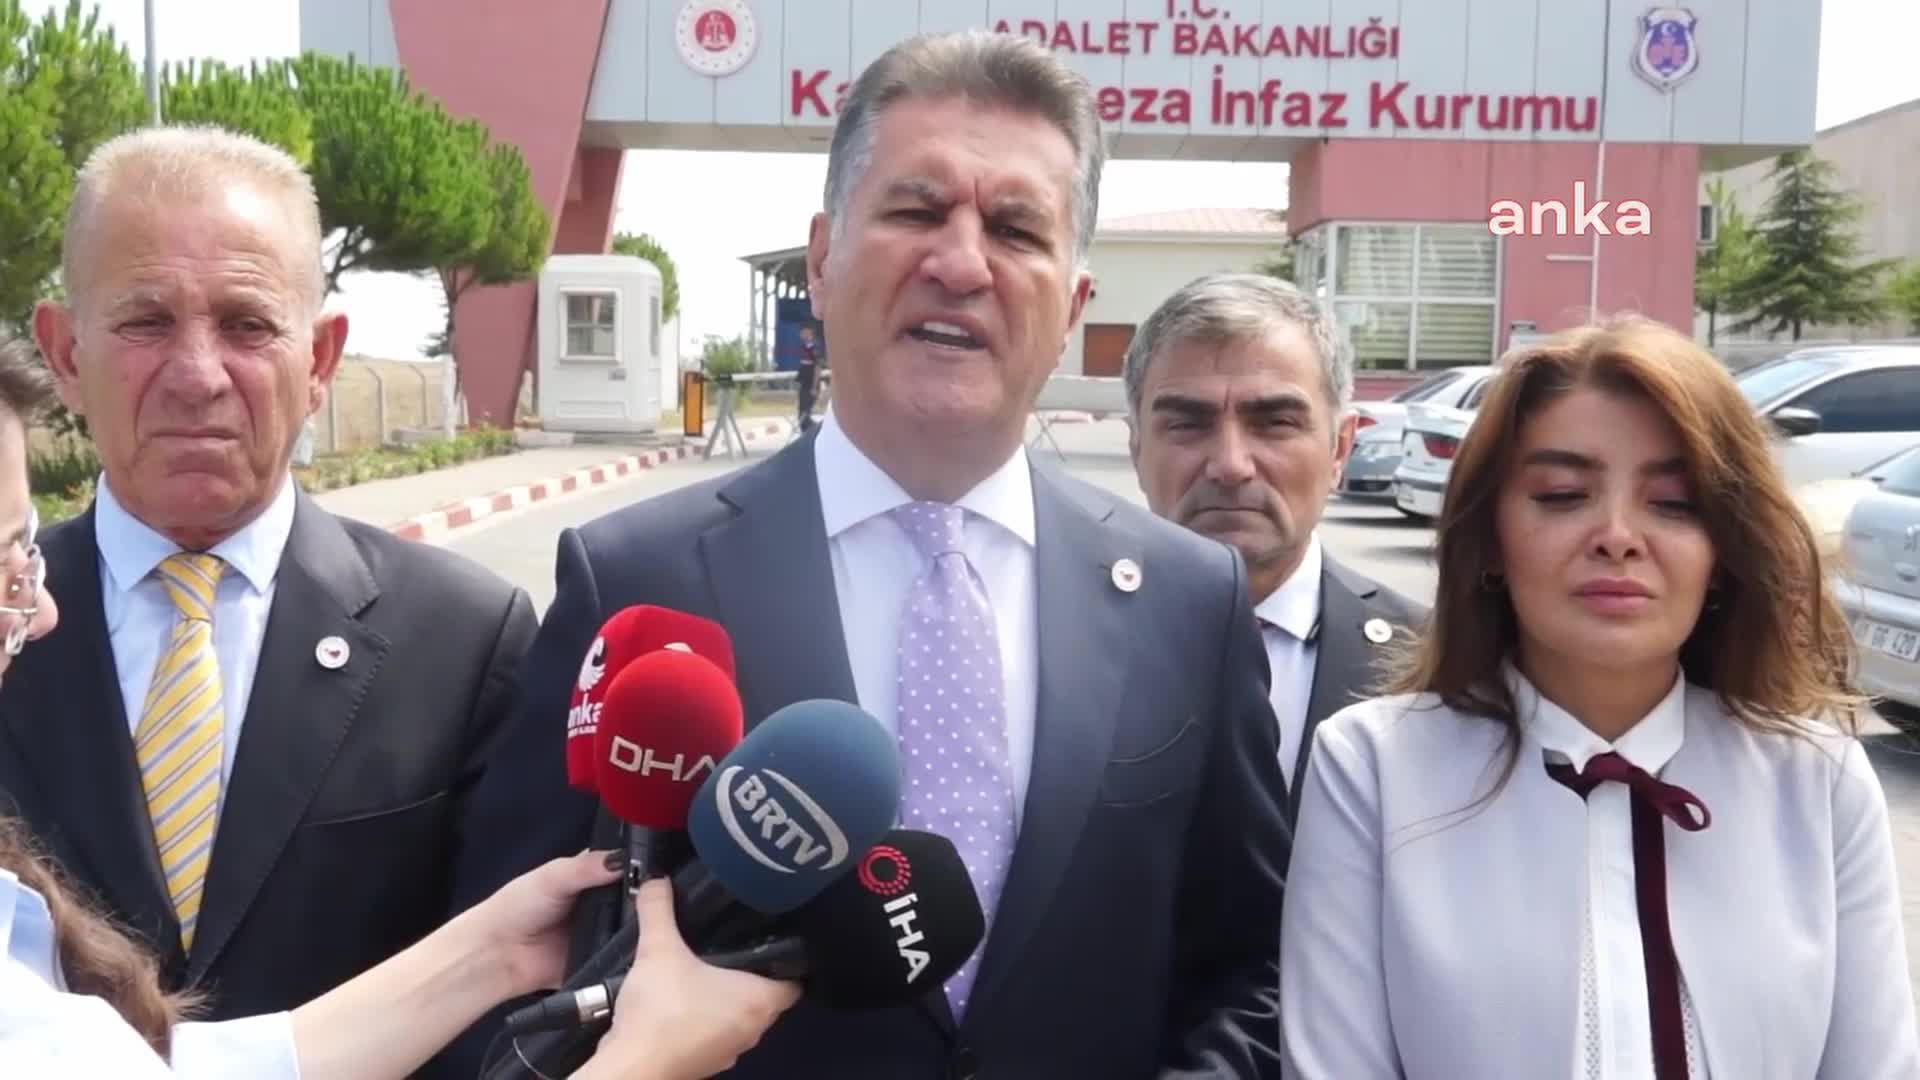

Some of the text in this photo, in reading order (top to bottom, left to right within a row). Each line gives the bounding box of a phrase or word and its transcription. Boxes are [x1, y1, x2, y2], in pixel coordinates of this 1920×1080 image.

[1173, 18, 1400, 58] BAKANLIĞI
[1210, 64, 1347, 128] İnfaz
[1368, 80, 1598, 131] Kurumu
[609, 735, 716, 785] DHA
[734, 774, 827, 865] BRTV
[883, 892, 931, 984] İHA
